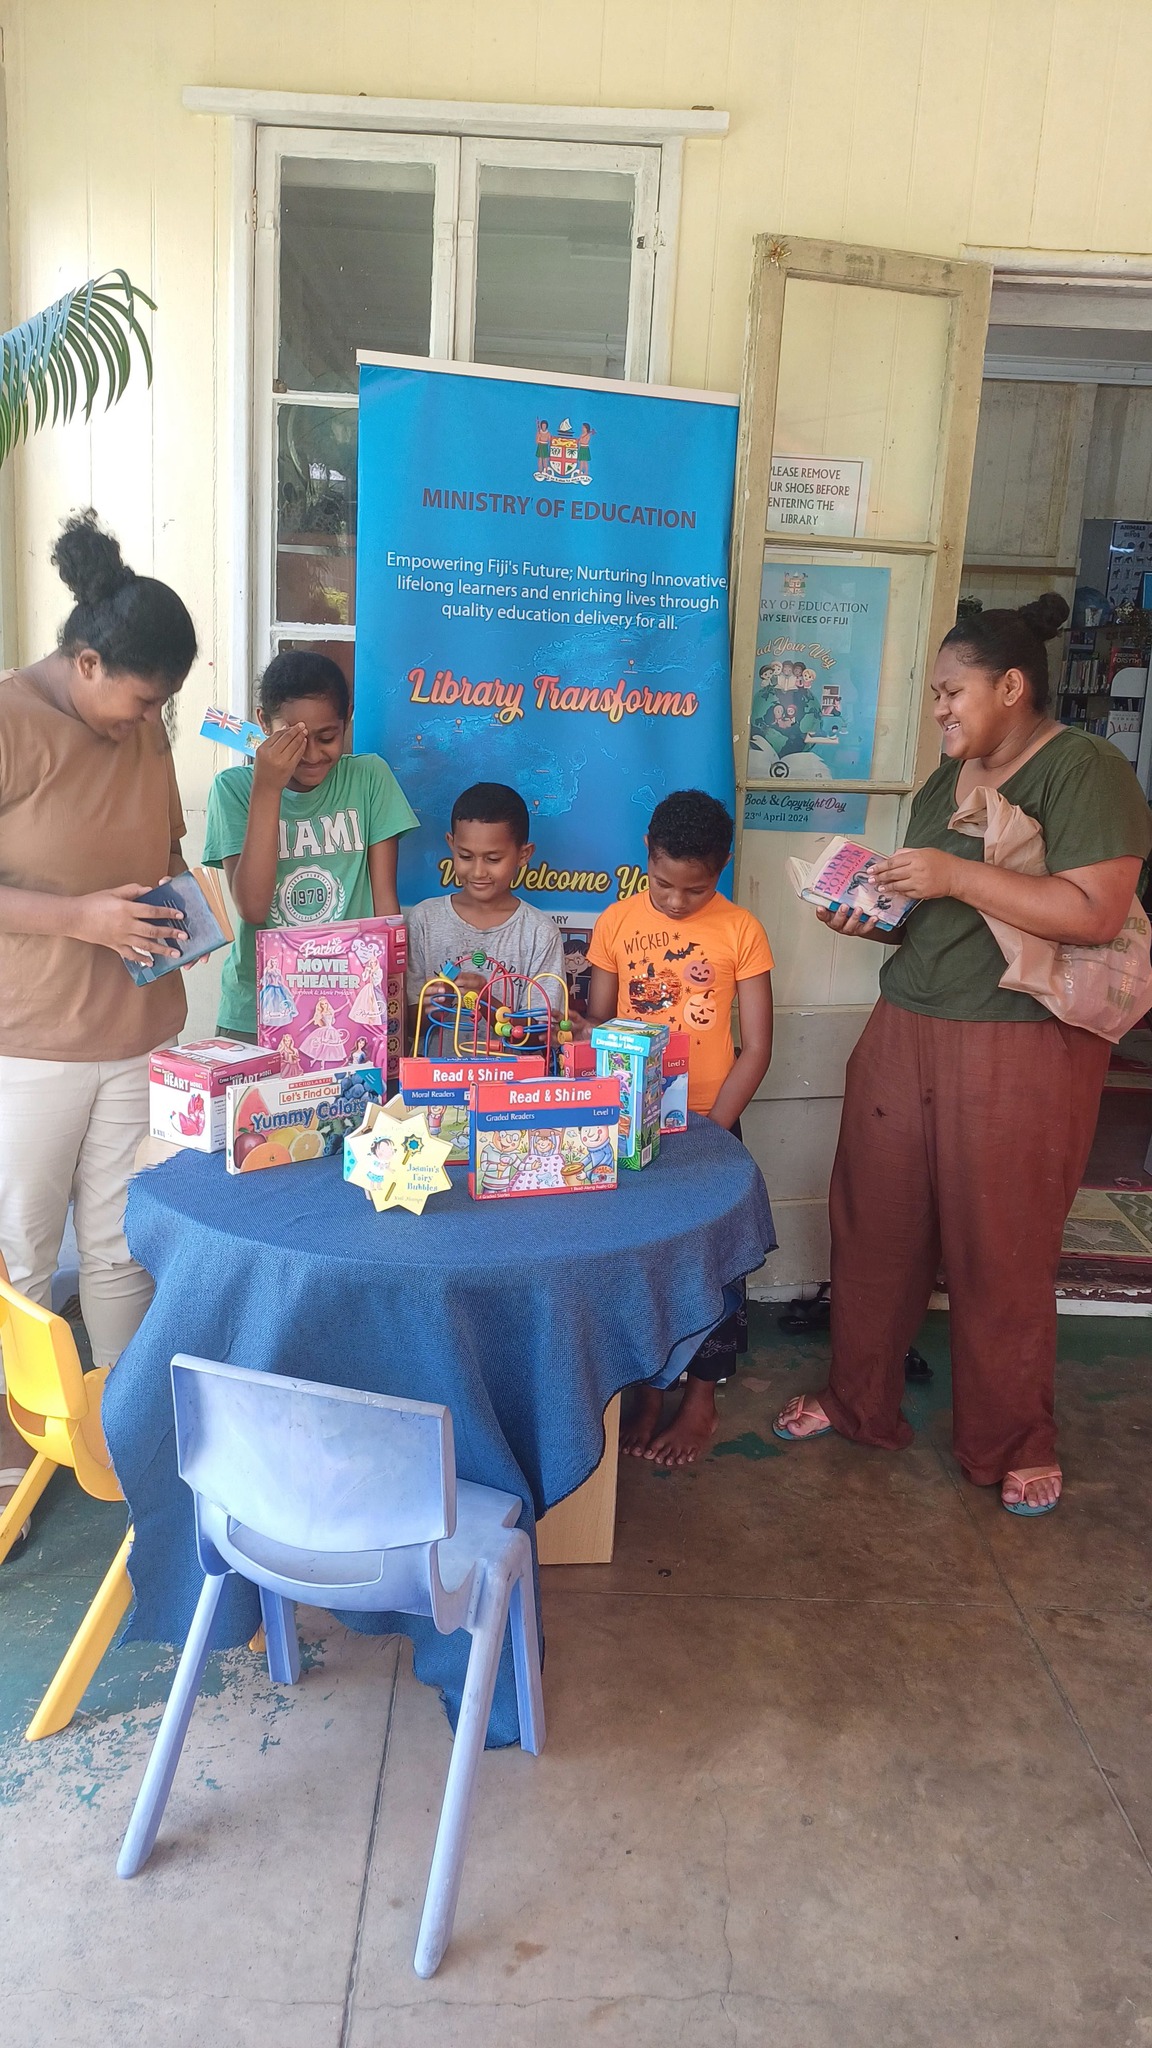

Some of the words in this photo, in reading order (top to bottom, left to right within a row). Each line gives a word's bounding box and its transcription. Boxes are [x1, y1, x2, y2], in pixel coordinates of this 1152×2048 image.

[801, 468, 841, 480] REMOVE
[770, 483, 783, 492] UR
[785, 483, 814, 494] SHOES
[816, 485, 850, 496] BEFORE
[422, 488, 531, 515] MINISTRY
[536, 498, 565, 518] OF
[571, 501, 696, 529] EDUCATION
[768, 497, 814, 510] ENTERING
[817, 500, 834, 510] THE
[781, 514, 818, 525] LIBRARY
[387, 552, 484, 577] Empowering
[488, 558, 518, 578] Fiji's
[522, 561, 573, 581] Future;
[577, 566, 647, 588] Nurturing
[651, 570, 728, 591] Innovative,
[397, 574, 454, 597] lifelong
[458, 580, 517, 598] learners
[521, 584, 548, 602] and
[553, 588, 622, 608] enriching
[626, 591, 656, 607] lives
[659, 593, 719, 610] through
[780, 600, 796, 610] OF
[798, 601, 869, 613] EDUCATION
[442, 602, 494, 621] quality
[498, 604, 570, 624] education
[574, 609, 632, 630] delivery
[636, 613, 654, 629] for
[658, 615, 678, 630] all.
[776, 614, 818, 624] SERVICES
[820, 616, 831, 624] OF
[833, 617, 848, 625] FIJI
[757, 640, 772, 656] ad
[773, 636, 806, 656] Your
[808, 643, 837, 670] Way
[408, 668, 523, 723] Library
[533, 674, 698, 723] Transforms
[745, 794, 767, 806] Book
[769, 794, 779, 805] &
[781, 796, 825, 812] Copyright
[825, 799, 847, 813] Day
[745, 811, 761, 820] 23rd
[763, 812, 786, 823] April
[788, 814, 809, 822] 2024
[277, 807, 364, 860] IAMI
[815, 846, 853, 890] HARRY
[824, 850, 864, 895] POTTER
[616, 865, 650, 901] Yo
[292, 888, 325, 906] 1978
[299, 938, 346, 957] Barbie
[624, 932, 670, 955] WICKED
[297, 958, 349, 973] MOVIE
[286, 974, 361, 990] THEATER
[164, 1072, 189, 1091] HEART
[433, 1068, 463, 1082] Read
[467, 1068, 475, 1081] &
[478, 1068, 514, 1080] Shine
[282, 1092, 301, 1102] Let's
[303, 1089, 321, 1099] Find
[324, 1086, 339, 1096] Out
[431, 1090, 455, 1098] Readers
[509, 1090, 540, 1104] Read
[544, 1090, 551, 1102] &
[555, 1088, 592, 1102] Shine
[252, 1108, 314, 1131] Yummy
[486, 1114, 509, 1122] Graded
[511, 1112, 535, 1121] Readers
[593, 1108, 609, 1116] Level
